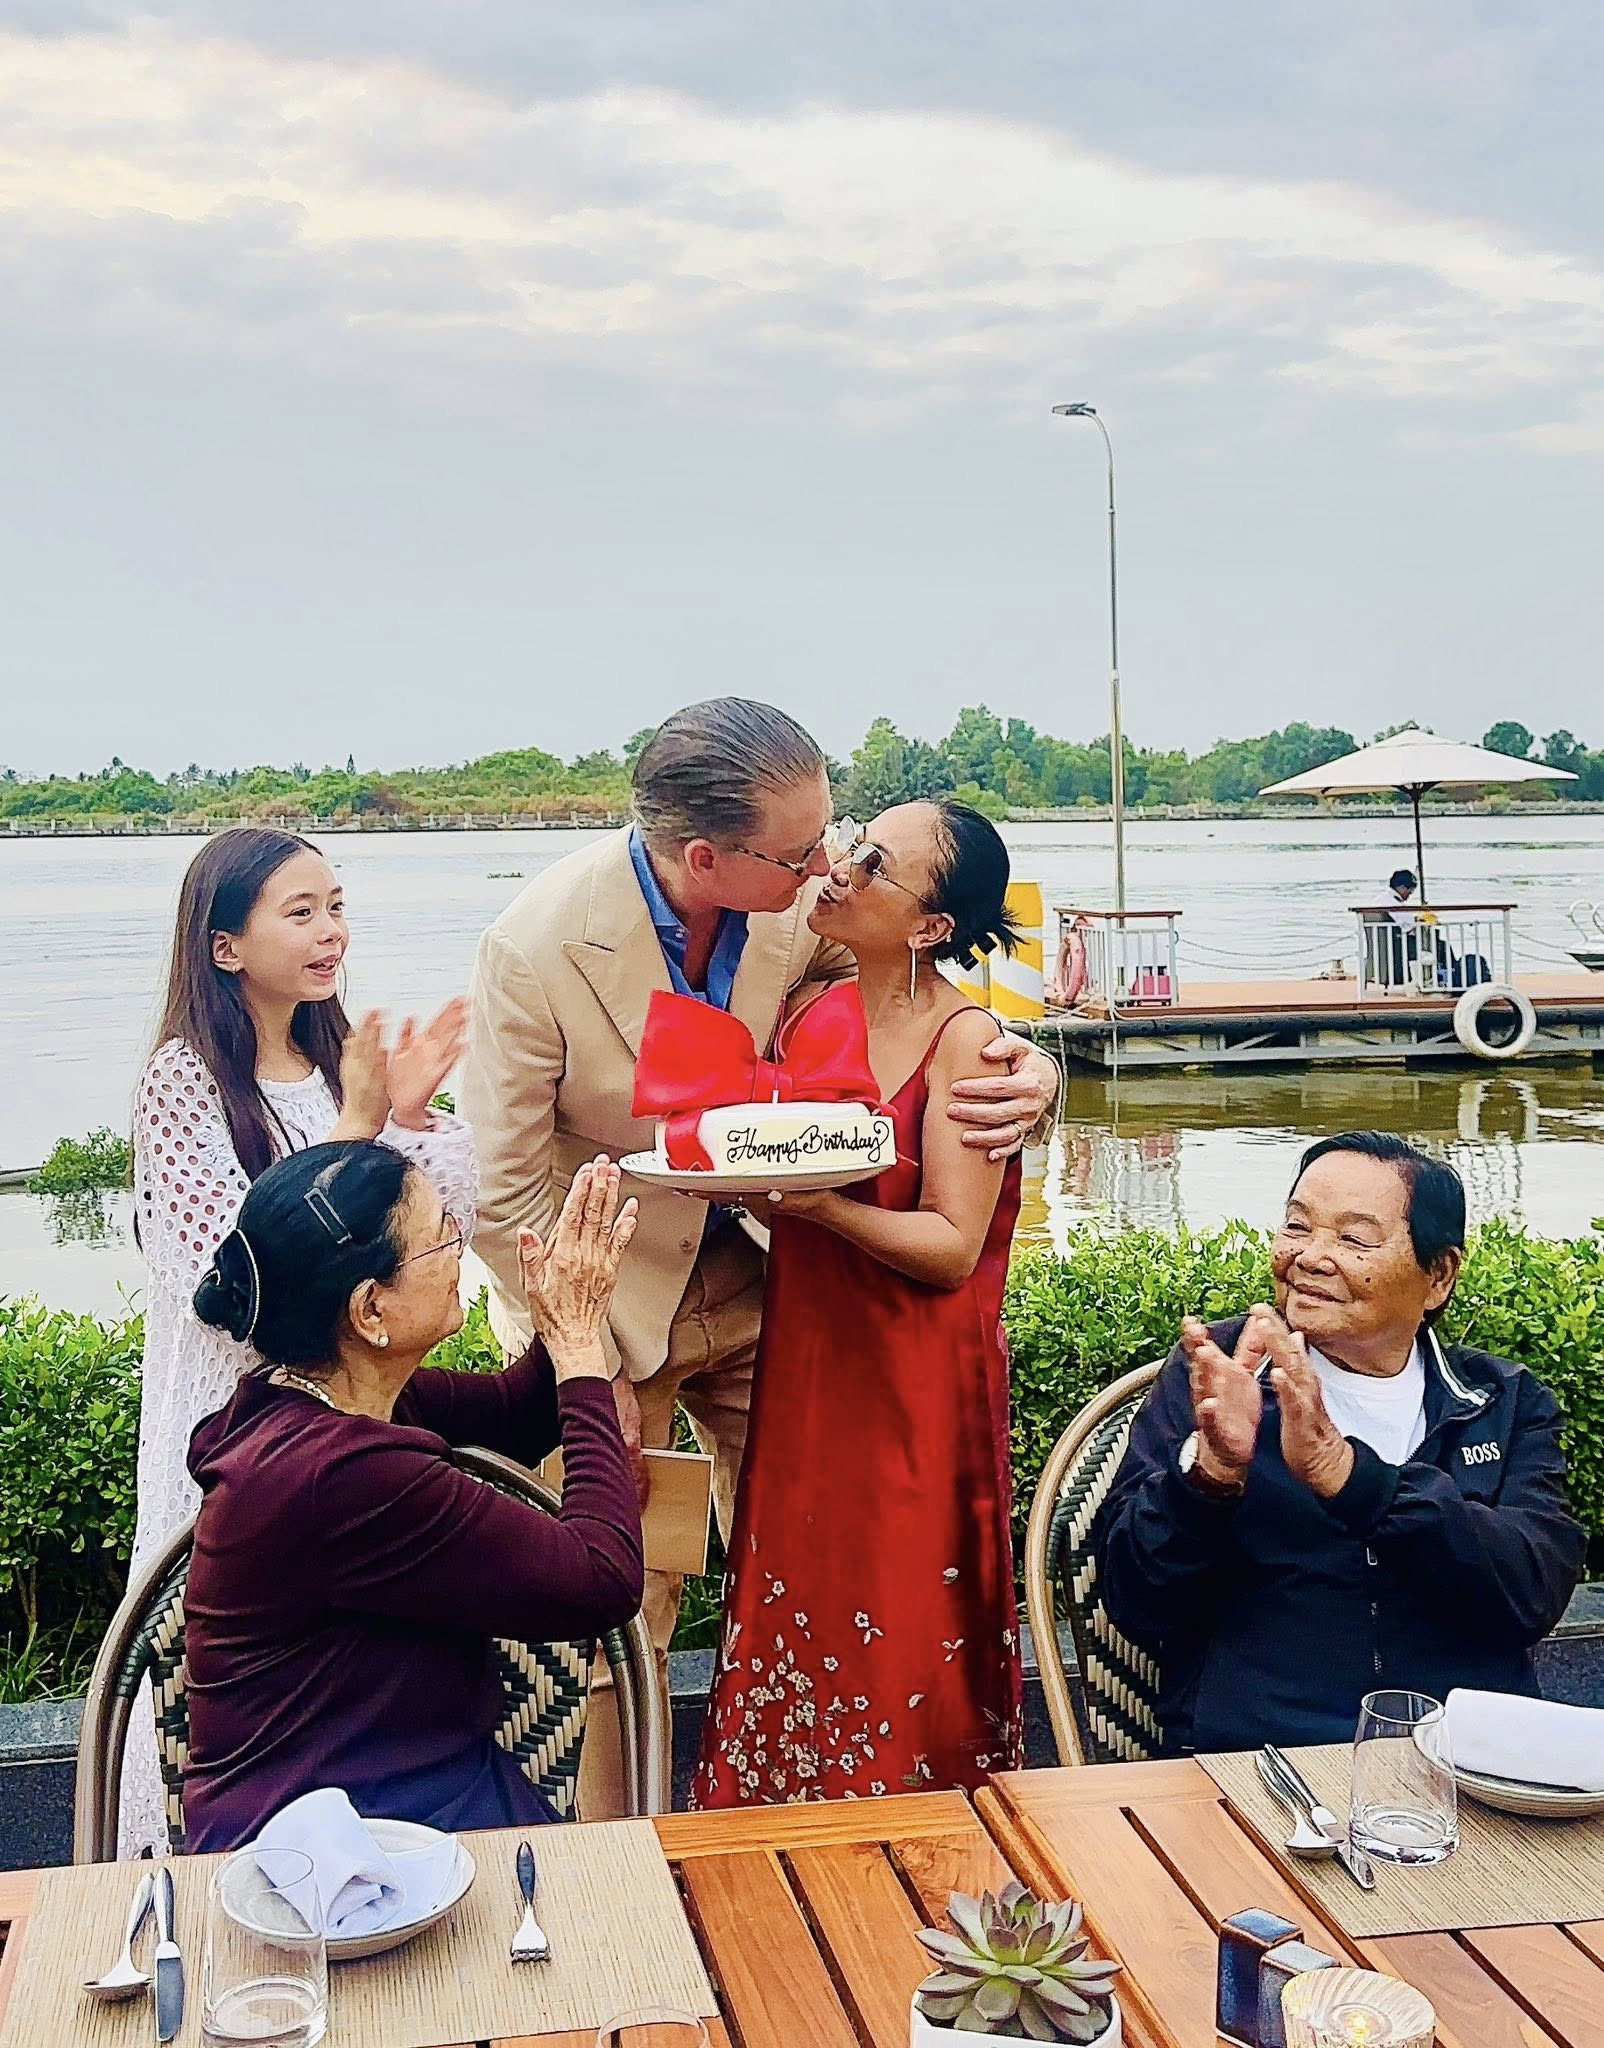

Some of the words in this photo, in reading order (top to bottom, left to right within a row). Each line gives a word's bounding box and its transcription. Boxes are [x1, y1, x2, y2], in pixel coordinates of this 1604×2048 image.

[727, 1127, 801, 1163] Happy
[799, 1120, 890, 1163] Birthday
[1461, 1441, 1501, 1466] BOSS
